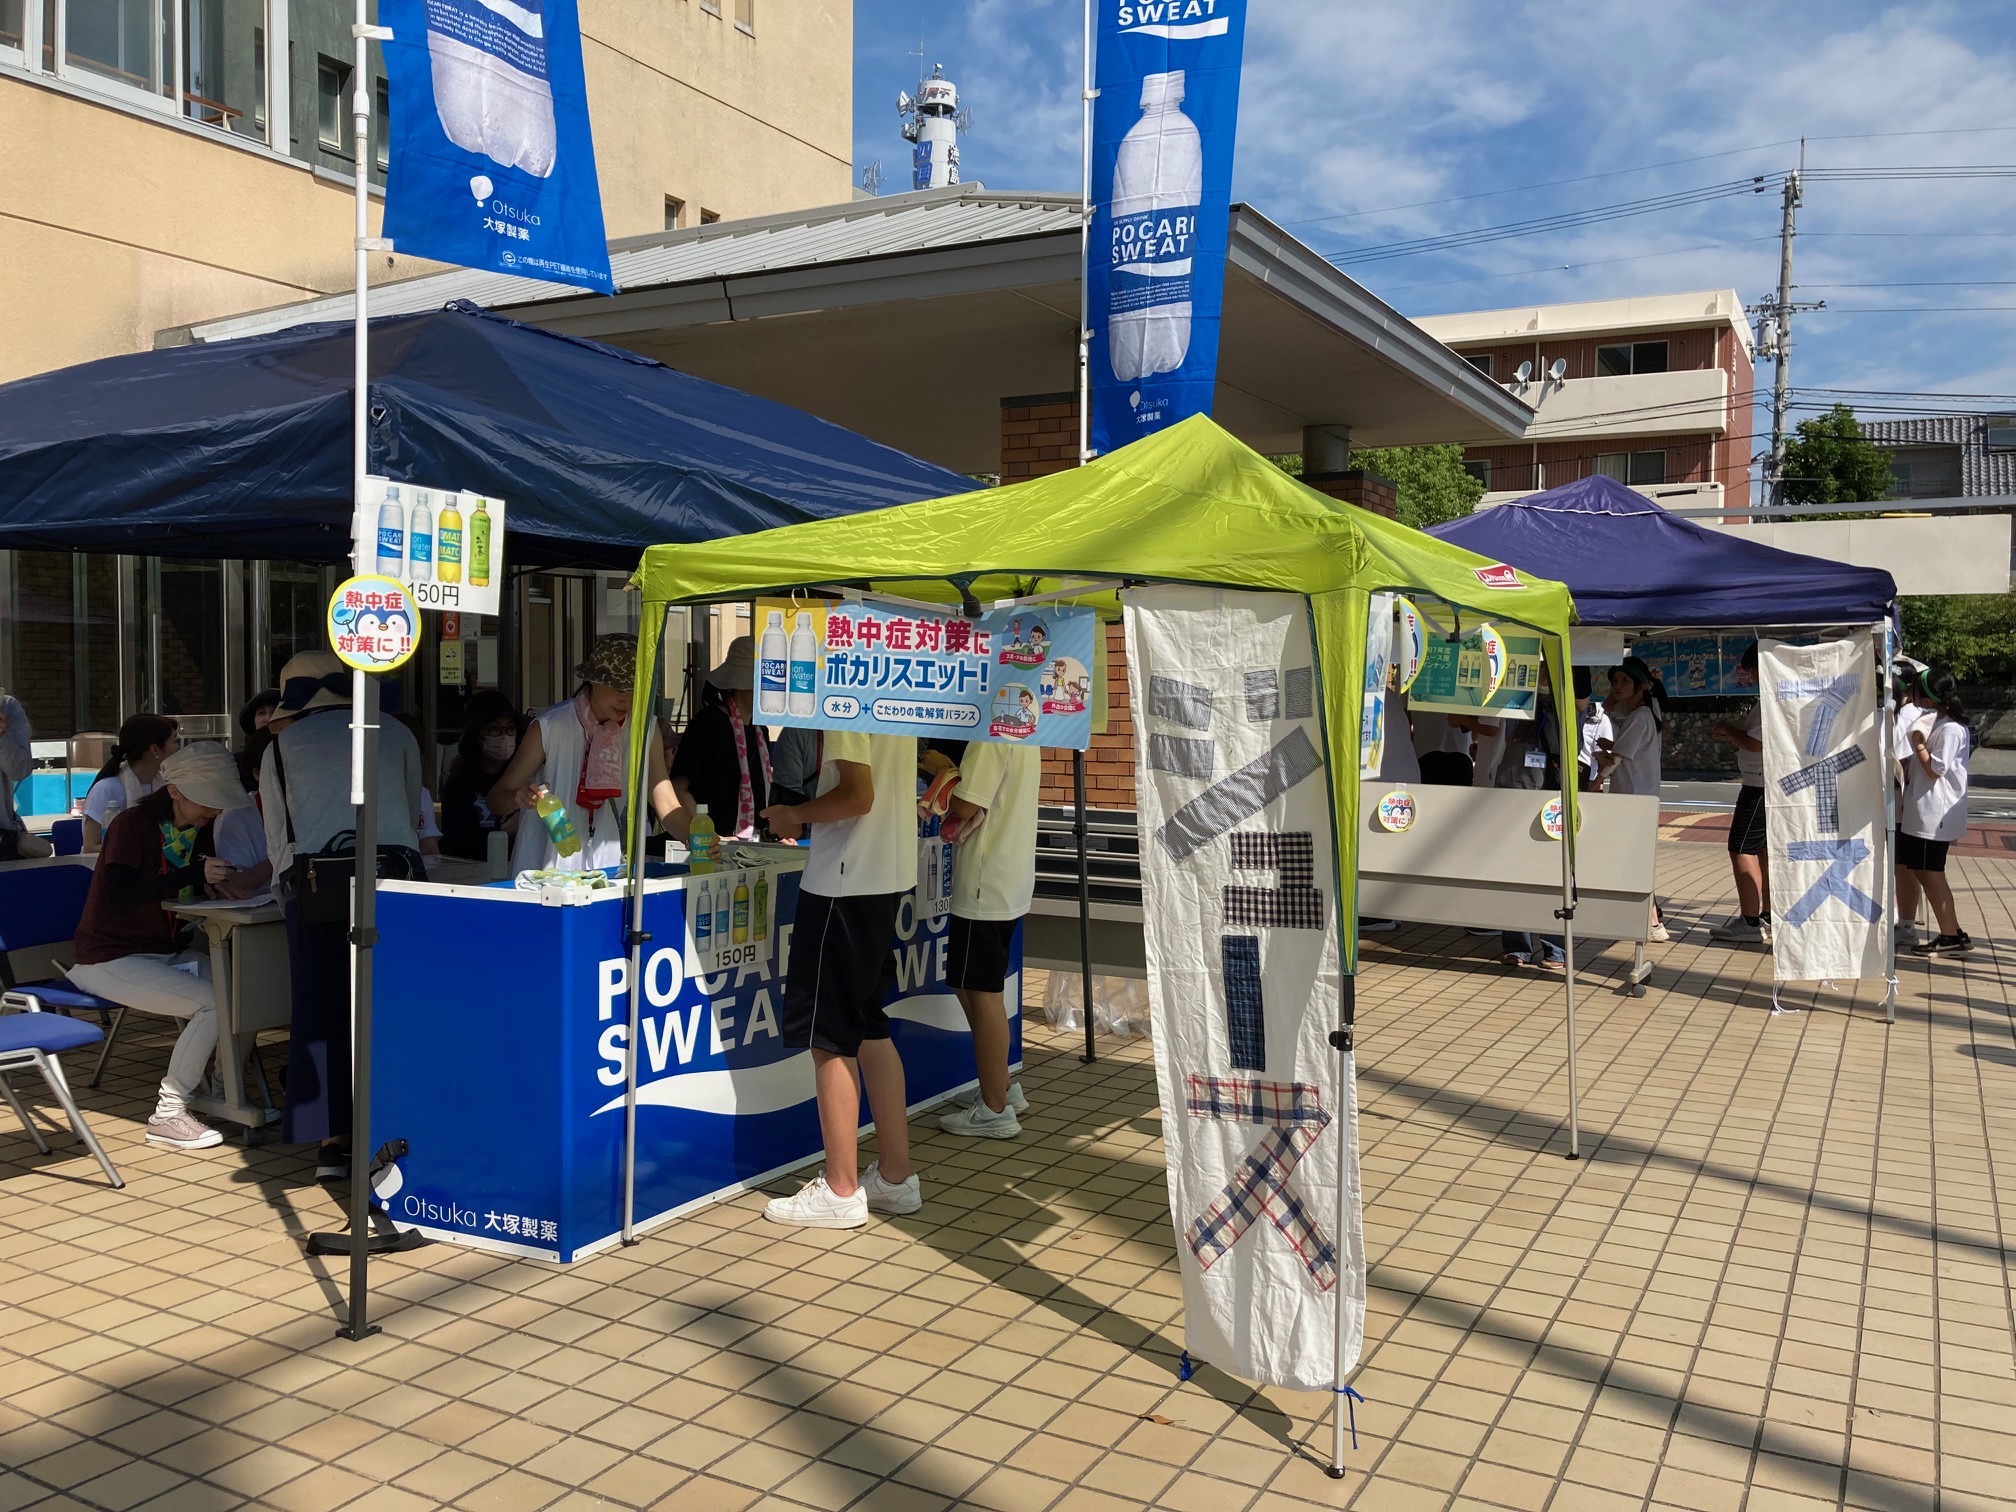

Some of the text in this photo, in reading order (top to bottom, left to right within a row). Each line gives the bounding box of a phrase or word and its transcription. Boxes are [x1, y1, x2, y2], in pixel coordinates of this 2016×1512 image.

[1117, 1, 1216, 26] SWEAT
[493, 200, 540, 225] Otsuka
[483, 216, 530, 241] 大塚製薬
[1112, 216, 1194, 245] POCARI
[1112, 235, 1188, 264] SWEAT
[344, 590, 404, 610] 熱中症
[407, 582, 459, 606] 150円
[827, 615, 990, 655] 熱中症対策に
[761, 668, 785, 676] SWEAT
[791, 672, 814, 680] water
[826, 652, 990, 693] ポカリスエット!
[831, 701, 852, 713] 水分
[877, 704, 976, 721] こだわりの電解質バランス
[1387, 797, 1411, 807] 熱中症
[1776, 673, 1885, 930] アイス
[715, 945, 756, 968] 150円
[597, 984, 787, 1086] SWEA
[404, 1195, 477, 1228] Otsuka
[484, 1210, 558, 1243] 大塚製薬
